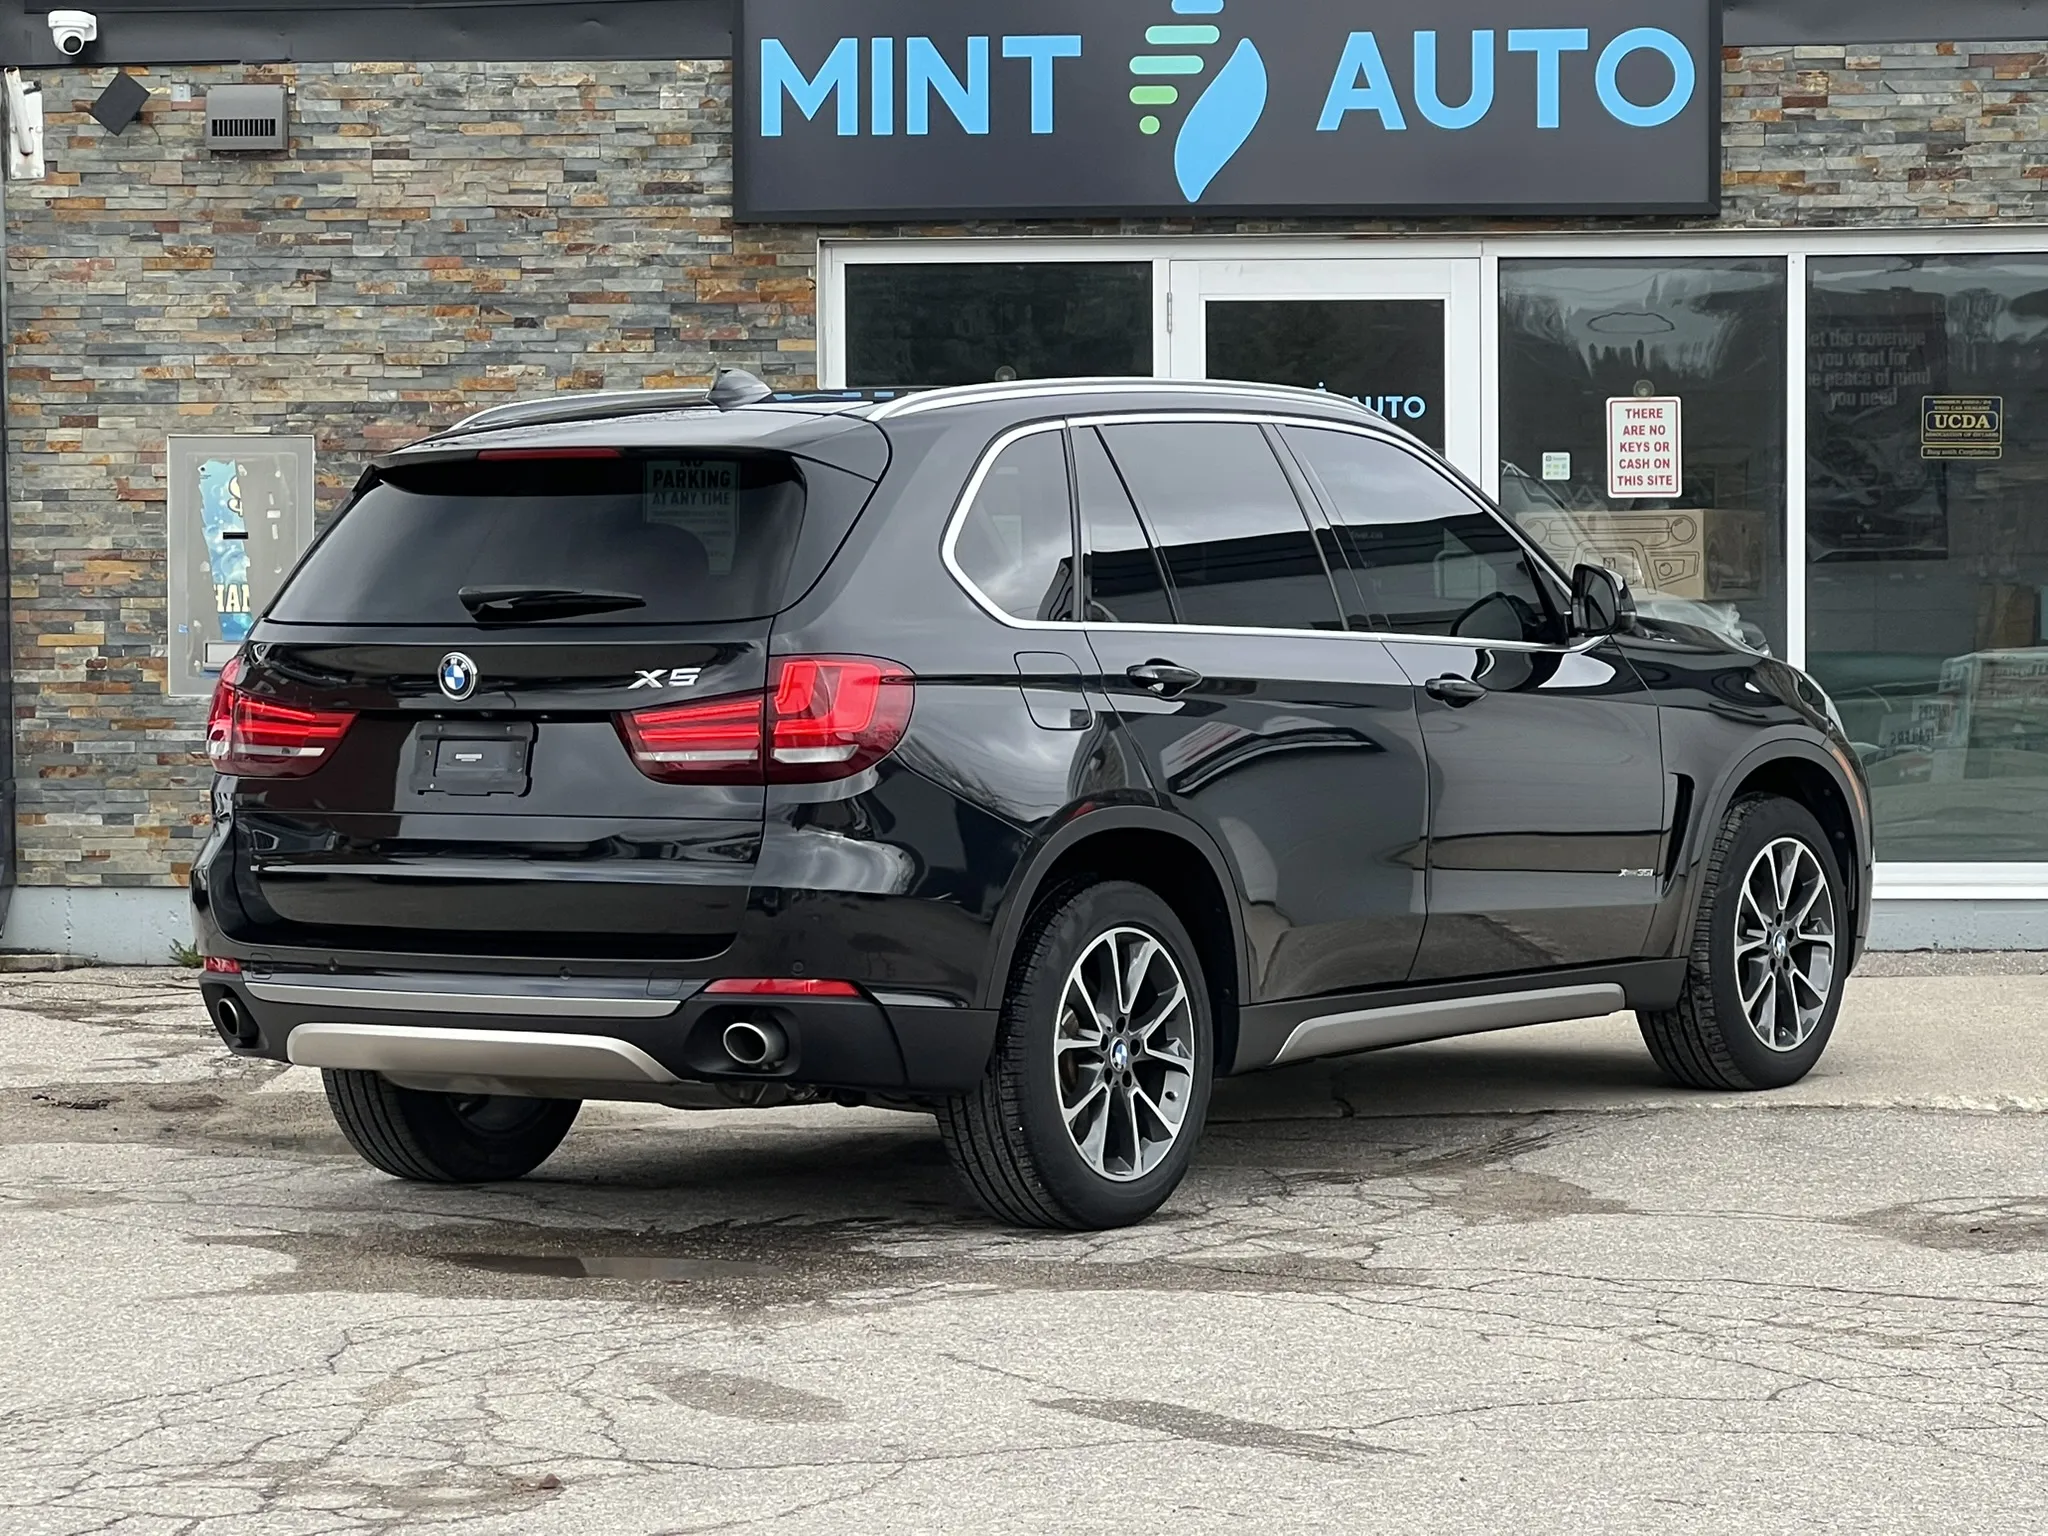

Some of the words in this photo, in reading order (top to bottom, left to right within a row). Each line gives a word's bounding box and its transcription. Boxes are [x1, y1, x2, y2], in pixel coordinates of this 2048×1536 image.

[760, 34, 1082, 137] MINT
[1316, 27, 1696, 132] AUTO
[1352, 396, 1426, 418] UTO
[1830, 392, 1856, 411] you
[1625, 408, 1663, 419] THERE
[1934, 414, 1991, 429] UCDA
[1623, 425, 1646, 436] ARE
[1649, 425, 1666, 435] NO
[1620, 442, 1650, 453] KEYS
[1654, 442, 1670, 452] OR
[1619, 459, 1650, 469] CASH
[1654, 458, 1670, 469] ON
[653, 469, 731, 489] PARKING
[1617, 475, 1644, 486] THIS
[1647, 475, 1672, 486] SITE
[670, 492, 697, 505] ANY
[627, 667, 702, 690] X5
